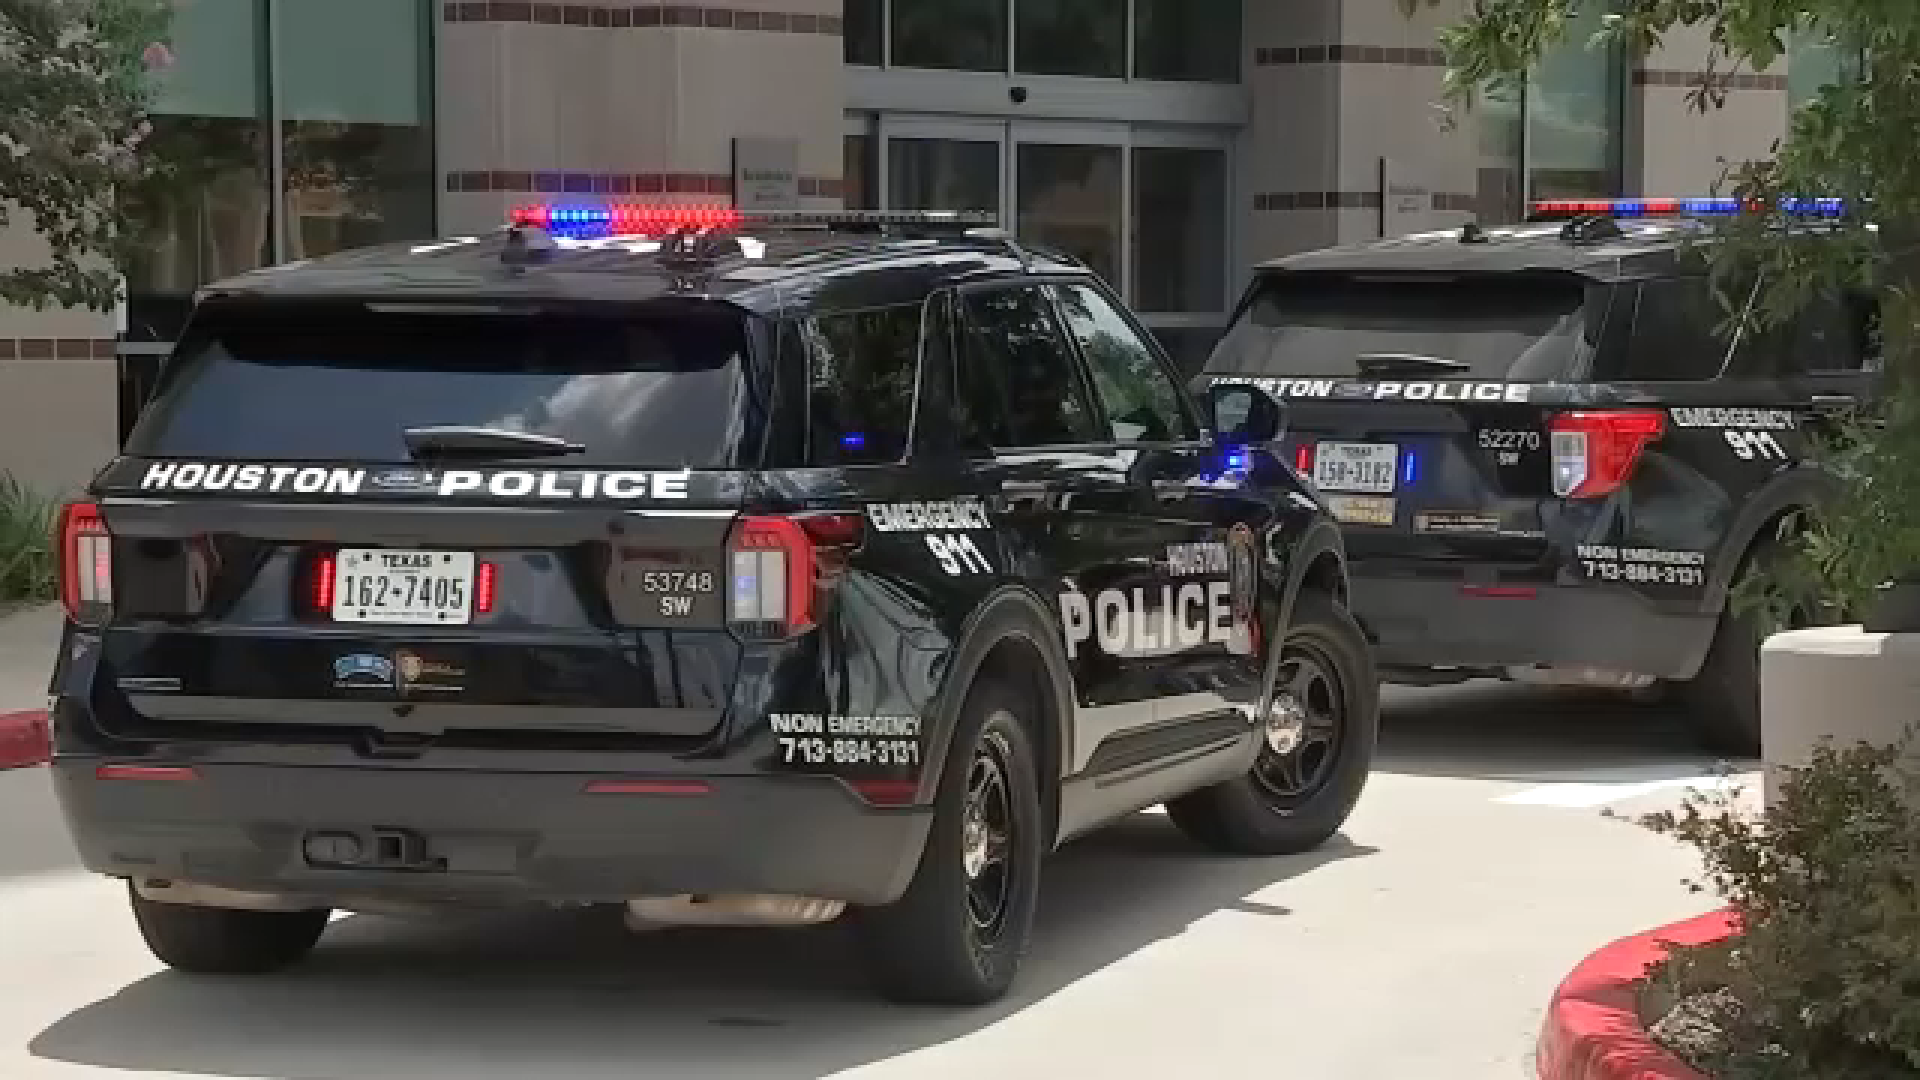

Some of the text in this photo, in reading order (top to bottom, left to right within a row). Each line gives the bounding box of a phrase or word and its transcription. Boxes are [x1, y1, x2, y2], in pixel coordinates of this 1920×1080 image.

[1373, 380, 1530, 402] POLICE
[1671, 407, 1794, 430] EMERGENCY
[1724, 430, 1788, 459] 911
[140, 461, 367, 495] HOUSTON
[437, 469, 690, 499] POLICE
[866, 501, 991, 532] EMERGENCY
[381, 553, 433, 568] TEXAS
[923, 533, 993, 576] 911
[1166, 542, 1228, 577] HOUSTON
[1577, 545, 1618, 559] NON
[341, 575, 466, 609] 162-7405
[644, 572, 712, 592] 53748
[660, 596, 694, 616] SW
[1058, 581, 1232, 661] POLICE
[769, 713, 922, 736] NON EMERGENCY
